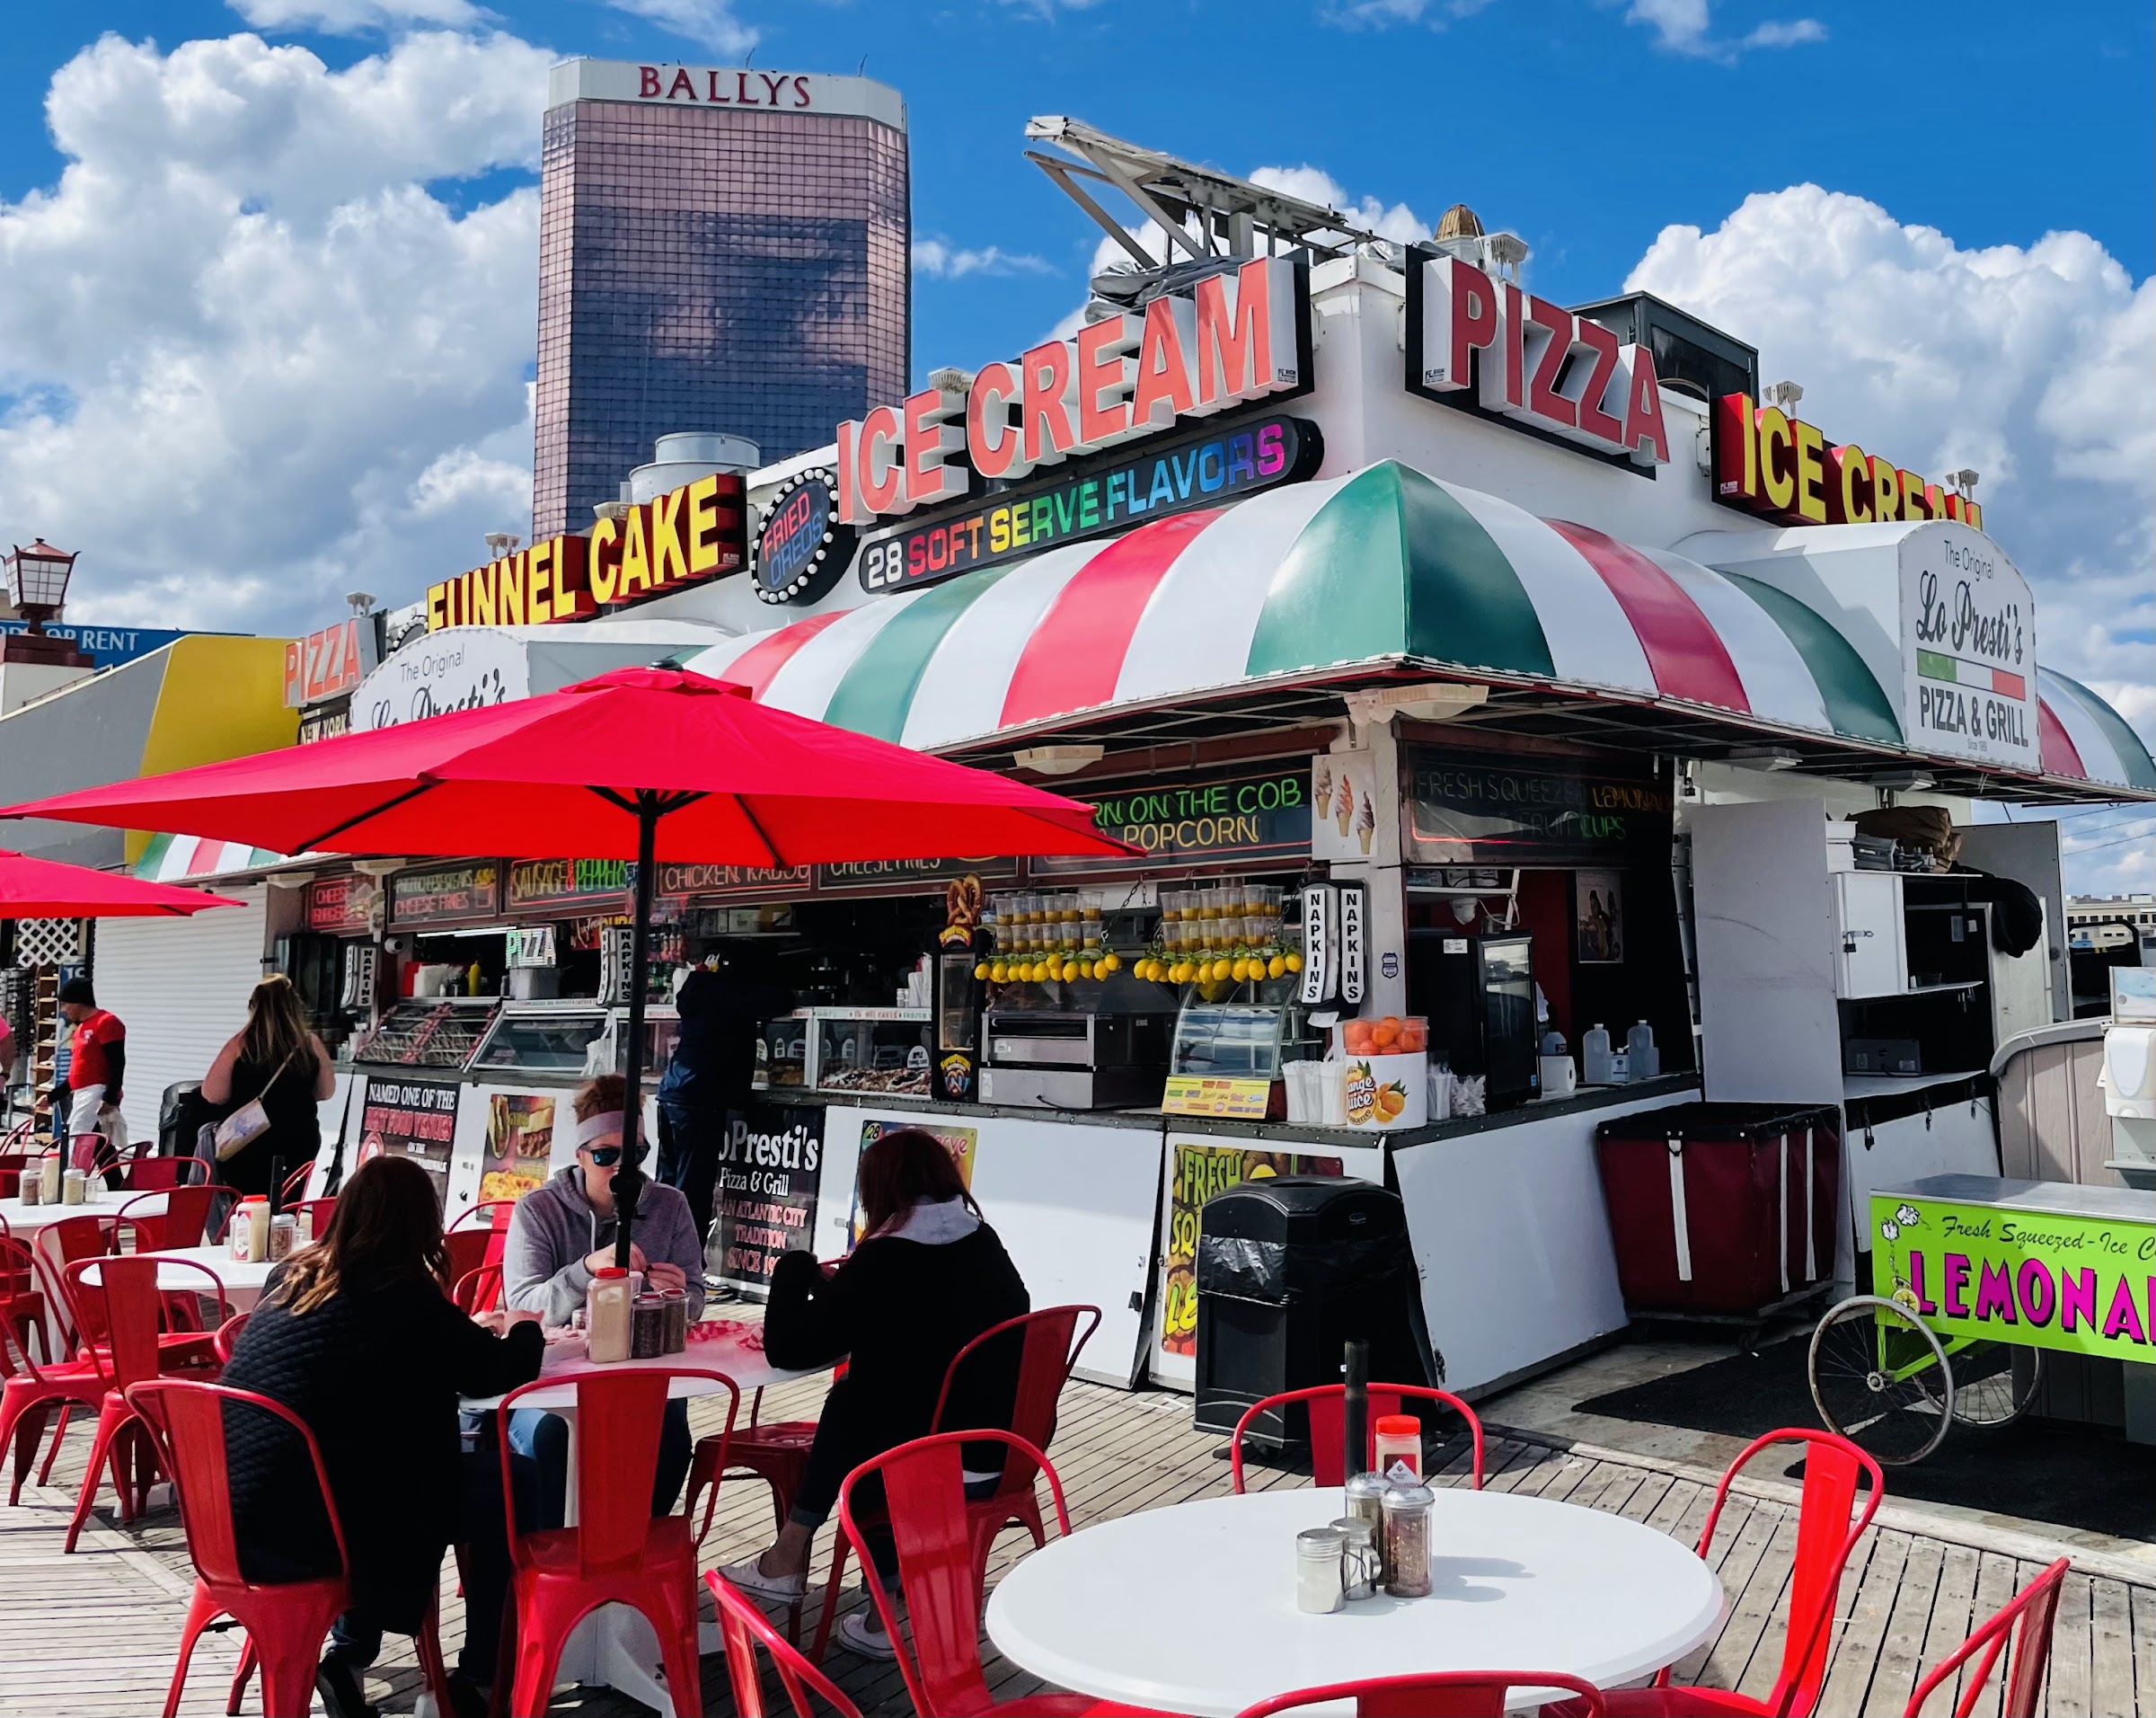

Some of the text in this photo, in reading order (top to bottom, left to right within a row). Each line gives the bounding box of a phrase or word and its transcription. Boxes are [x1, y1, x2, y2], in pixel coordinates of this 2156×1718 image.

[638, 66, 810, 107] BALLYS
[1451, 257, 1671, 464] PIZZA
[836, 256, 1276, 525] ICE CREAM
[1741, 394, 1827, 524] ICE
[764, 491, 811, 562] FRIED
[867, 423, 1286, 589] 28 SOFT SERVE FLAVORS
[426, 474, 720, 634] FUNNEL CAKE
[770, 510, 823, 586] OREOS
[1944, 539, 1994, 582] The Original
[1916, 570, 2023, 665] Lo Presti's
[82, 630, 139, 651] RENT
[285, 618, 360, 707] PIZZA
[401, 642, 465, 684] The Original
[301, 713, 348, 745] NEW YORK
[1920, 686, 2028, 748] PIZZA & GRILL
[1090, 777, 1302, 827] RN ON THE COB
[1417, 772, 1483, 801] FRESH
[1487, 774, 1587, 808] SQUEEZED
[1123, 814, 1260, 851] POPCORN
[513, 861, 568, 900] SAUSAGE
[665, 864, 742, 890] CHICKEN
[505, 926, 557, 970] PIZZA
[621, 932, 632, 1000] NAPKINS
[1308, 892, 1321, 998] NAPKINS
[1346, 892, 1359, 999] NAPKINS
[361, 950, 373, 1005] NAPKINS
[368, 1083, 456, 1111] NAMED ONE OF THE
[1348, 1076, 1375, 1094] ange
[1348, 1093, 1374, 1111] uice
[866, 1124, 881, 1140] 28
[935, 1133, 968, 1156] erve
[719, 1166, 790, 1197] Pizza & Grill
[1182, 1148, 1241, 1207] FRESH
[736, 1200, 783, 1225] ATLANTIC
[782, 1206, 808, 1228] CITY
[1941, 1216, 1992, 1239] Fresh
[735, 1223, 788, 1250] TRADITION
[727, 1246, 762, 1273] SINCE
[1909, 1250, 2156, 1346] LEMONA
